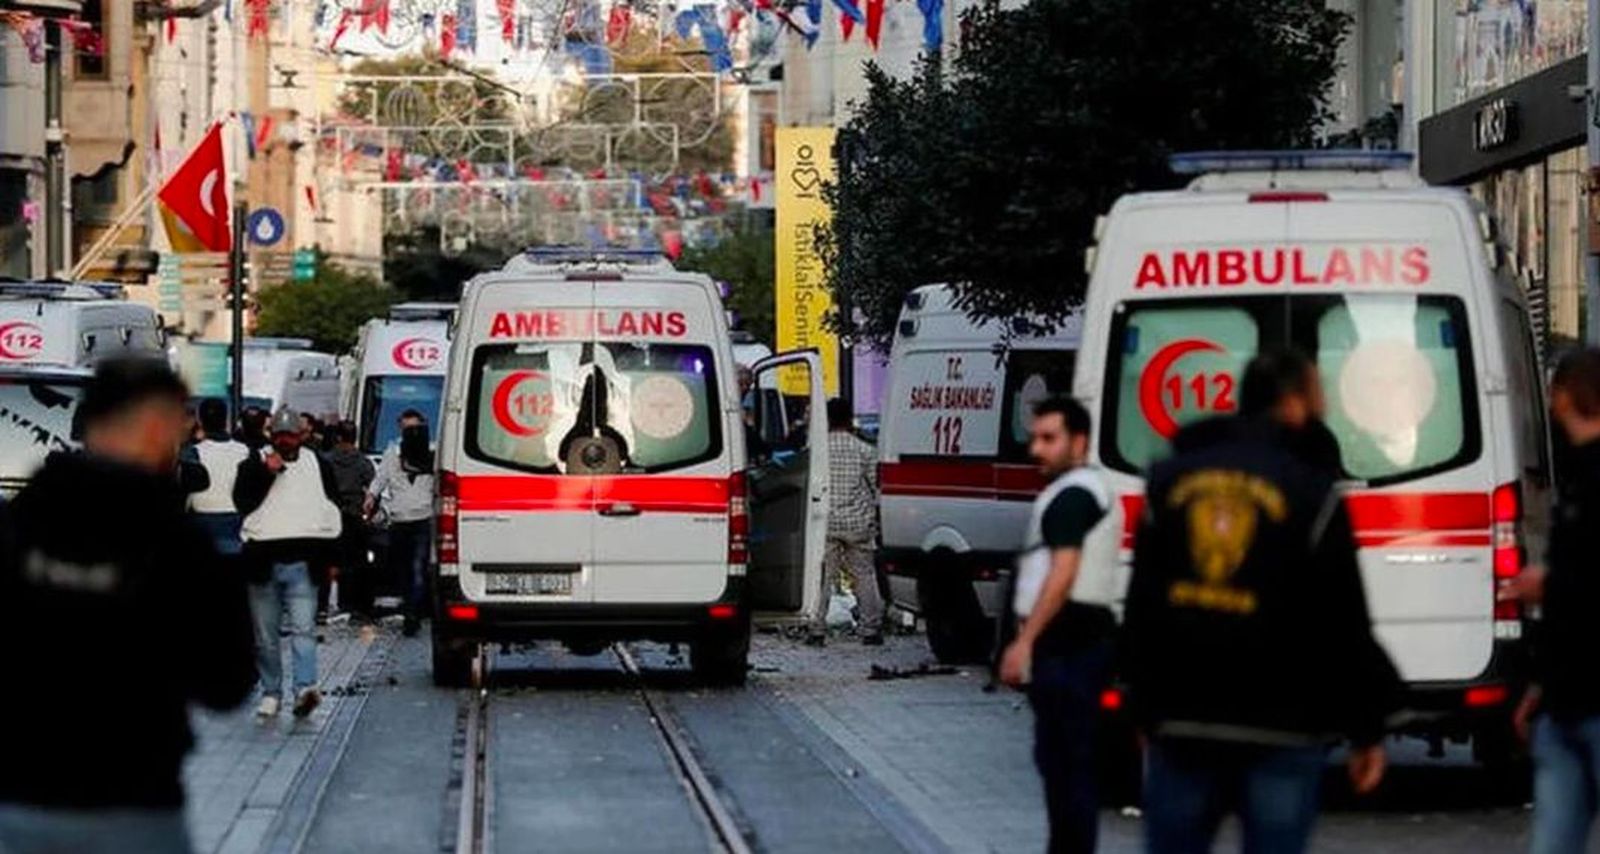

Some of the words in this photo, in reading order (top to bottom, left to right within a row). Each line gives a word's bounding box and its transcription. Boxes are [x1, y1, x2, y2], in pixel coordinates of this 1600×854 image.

[1134, 247, 1431, 289] AMBULANS
[3, 333, 43, 350] 112
[407, 347, 440, 360] 112
[514, 393, 553, 416] 112
[1166, 373, 1236, 411] 112
[933, 416, 963, 453] 112
